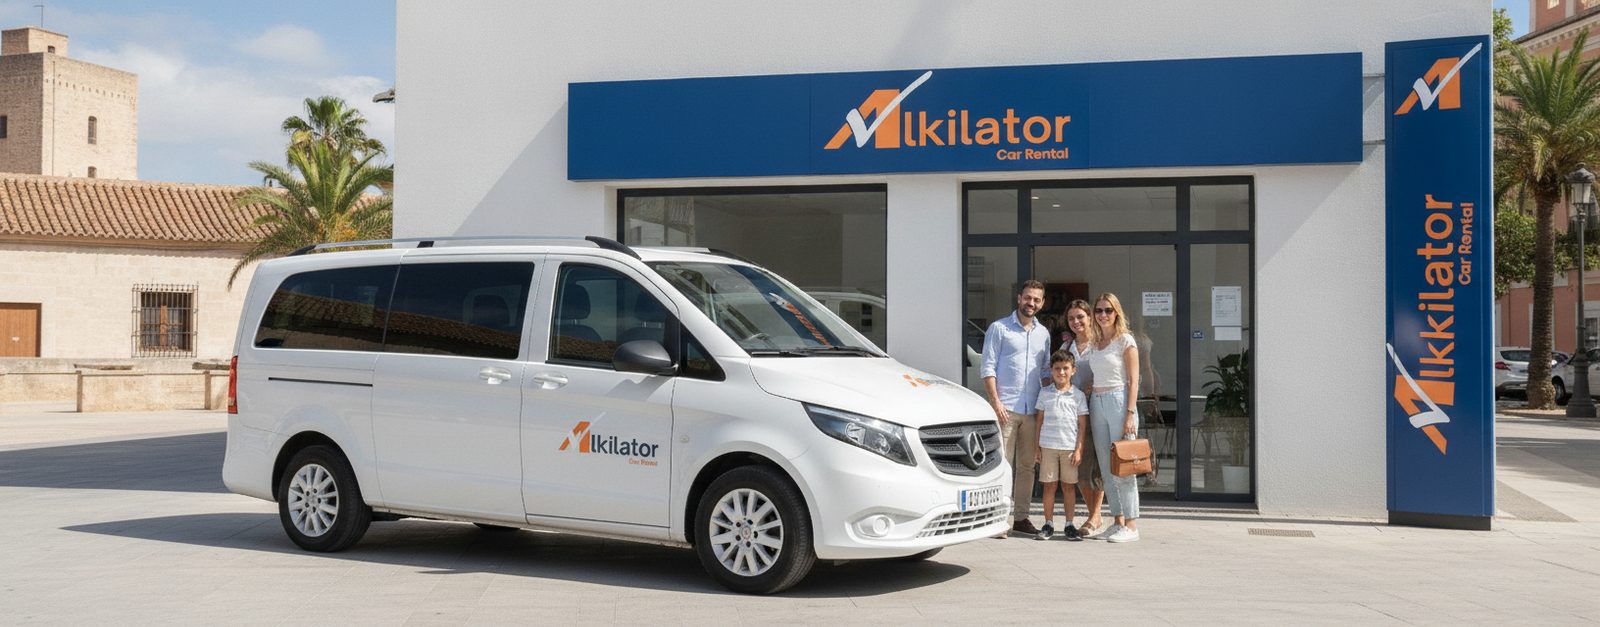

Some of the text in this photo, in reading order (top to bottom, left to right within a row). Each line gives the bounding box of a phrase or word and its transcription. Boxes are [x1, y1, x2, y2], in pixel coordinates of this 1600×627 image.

[823, 88, 1072, 150] Alkilator
[996, 147, 1069, 161] Car Rental
[1458, 257, 1472, 286] Car
[559, 421, 659, 458] Alkilator
